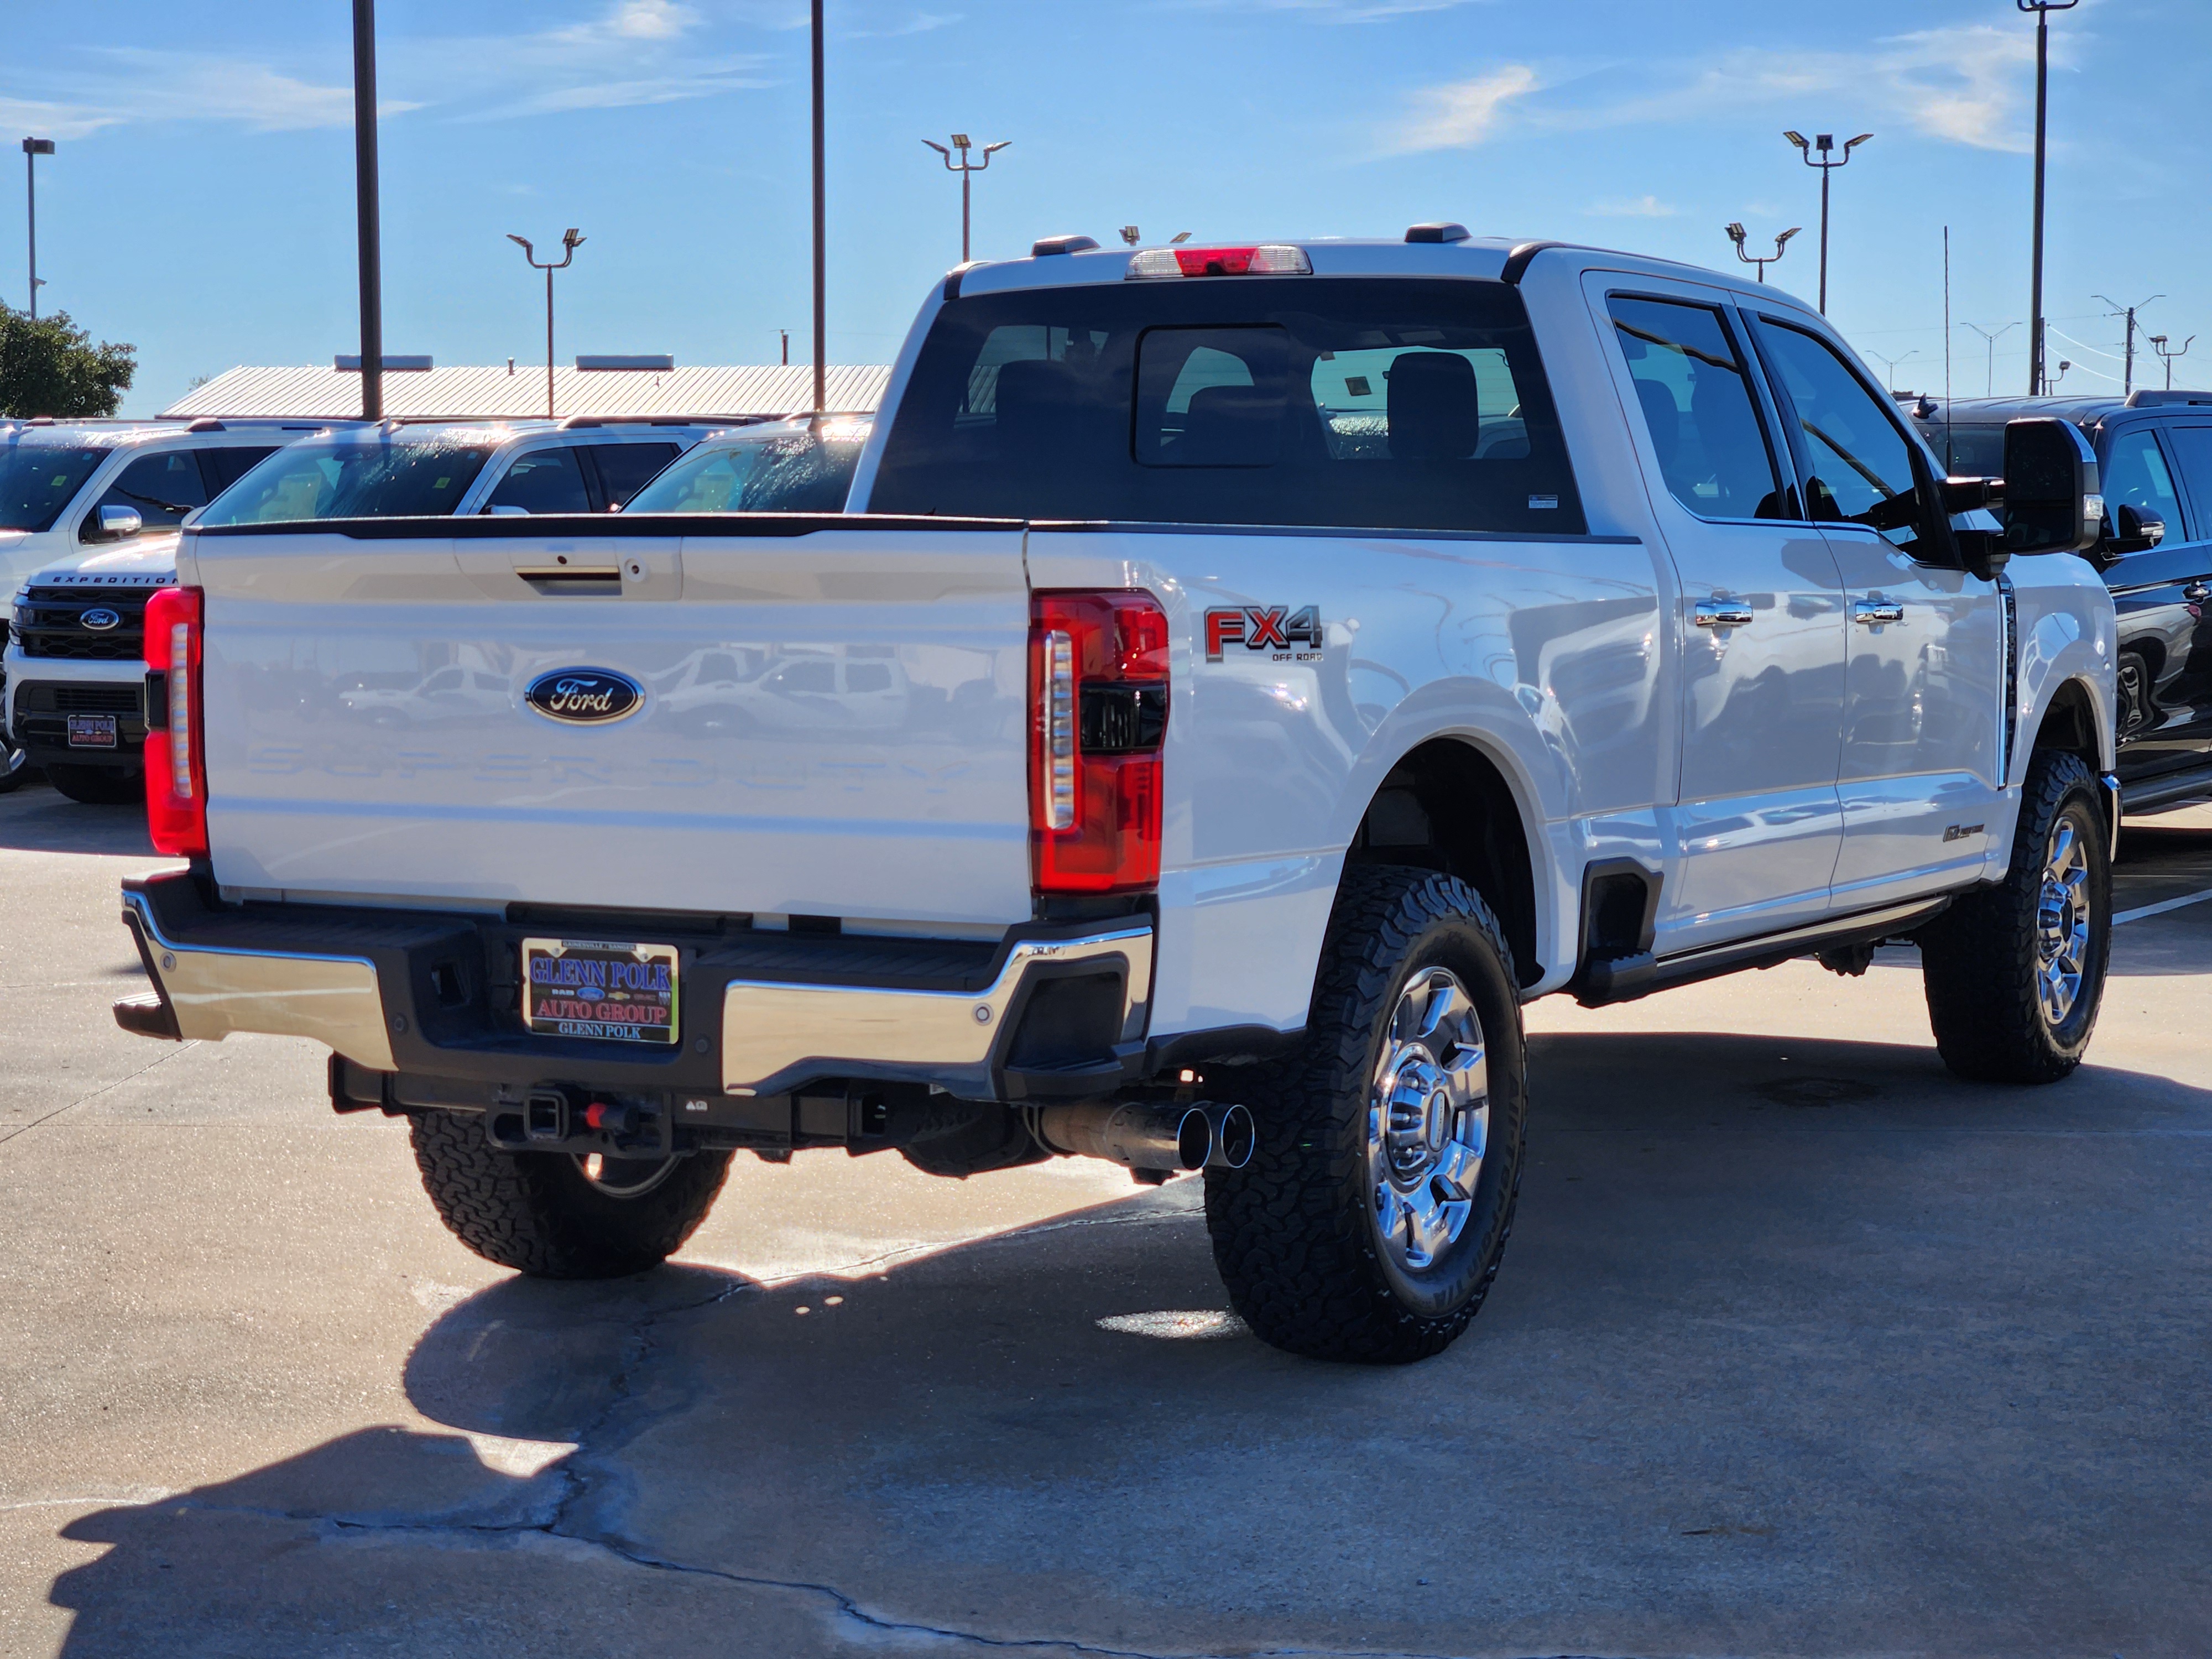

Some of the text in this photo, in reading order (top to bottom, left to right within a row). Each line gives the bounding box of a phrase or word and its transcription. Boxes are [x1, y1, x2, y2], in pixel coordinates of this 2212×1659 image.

[88, 613, 109, 624] Ford
[1204, 605, 1323, 664] FX4
[1272, 653, 1324, 662] OFF ROAD
[550, 678, 614, 711] Ford
[248, 743, 972, 794] SUPER DUTY
[530, 957, 672, 991] GLENN POLK
[536, 999, 667, 1024] AUTO GROUP
[558, 1022, 641, 1039] GLENN POLK
